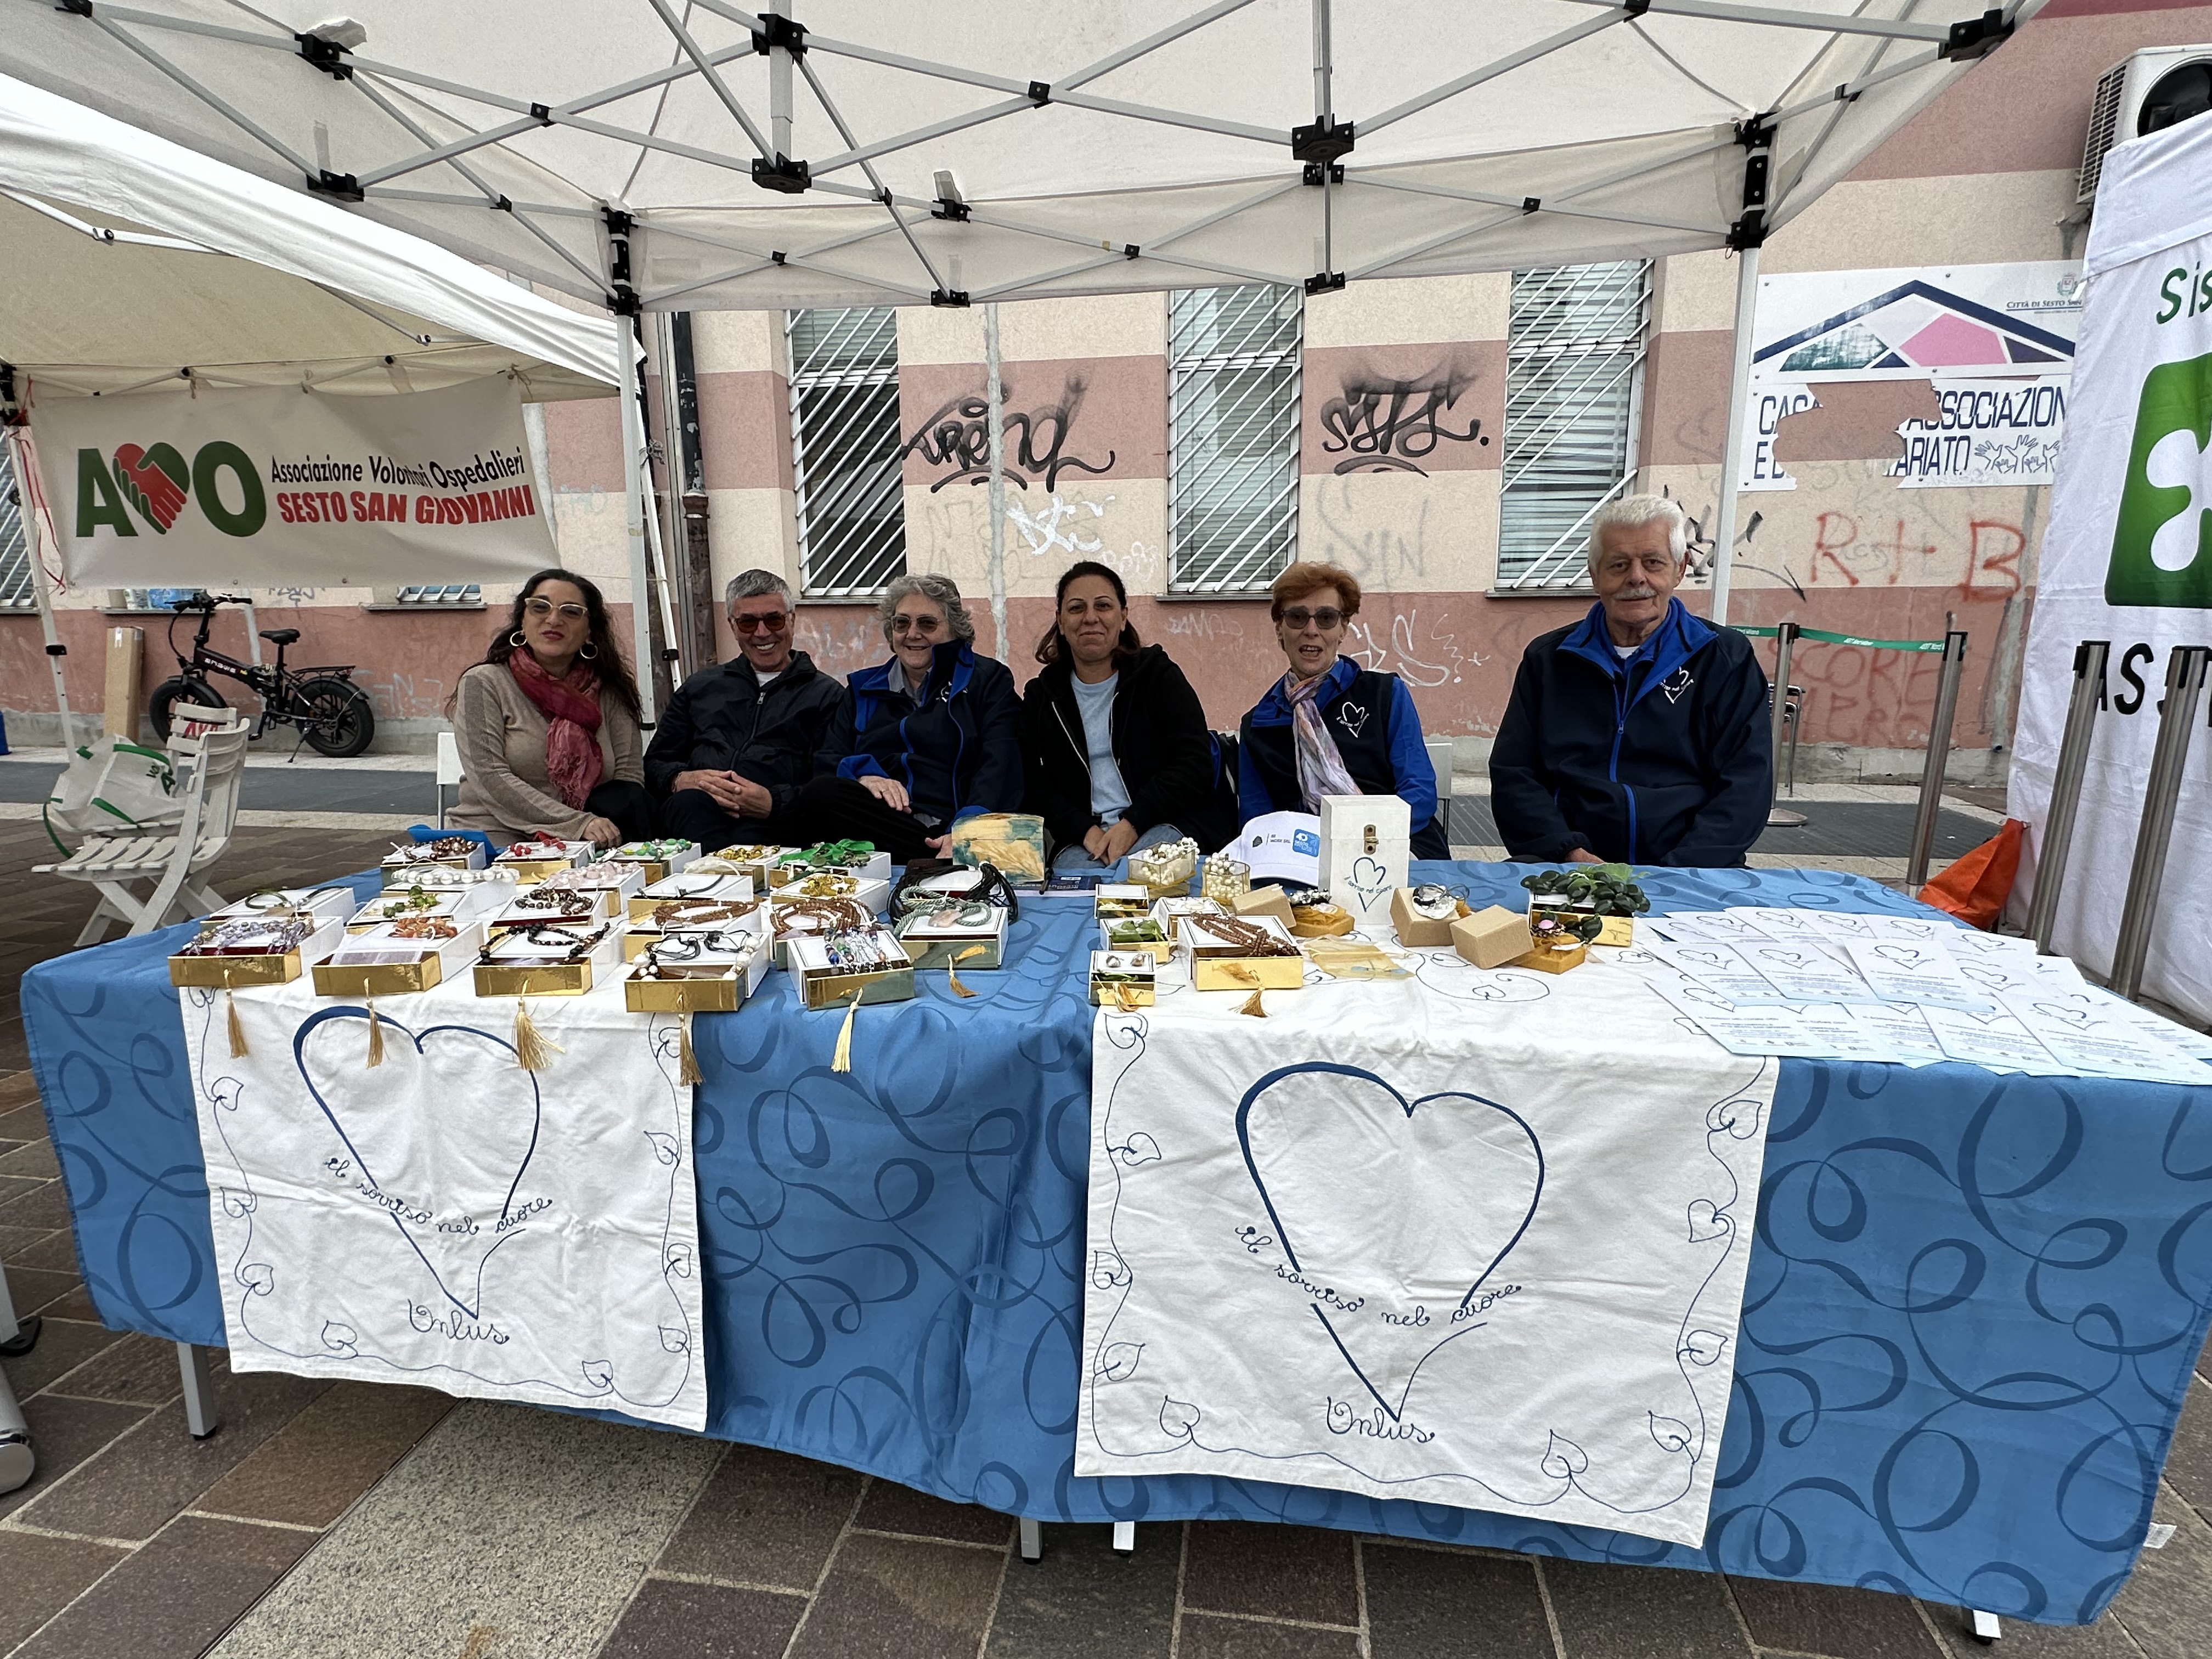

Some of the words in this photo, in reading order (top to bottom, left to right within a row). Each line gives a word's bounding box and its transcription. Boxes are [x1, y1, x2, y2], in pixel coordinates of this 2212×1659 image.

[272, 454, 363, 483] Associazione
[428, 446, 526, 493] Ospedalieri
[276, 492, 348, 524] SESTO
[350, 491, 407, 524] SAN
[415, 484, 535, 526] GIOVANNI
[356, 1182, 432, 1224] sorriso
[435, 1216, 480, 1235] nel
[495, 1197, 553, 1233] cuore
[1274, 1263, 1365, 1313] sorriso
[1381, 1306, 1431, 1327] nel
[1450, 1284, 1522, 1325] cuore
[407, 1299, 510, 1345] Onlus
[1325, 1395, 1436, 1444] Onlus
